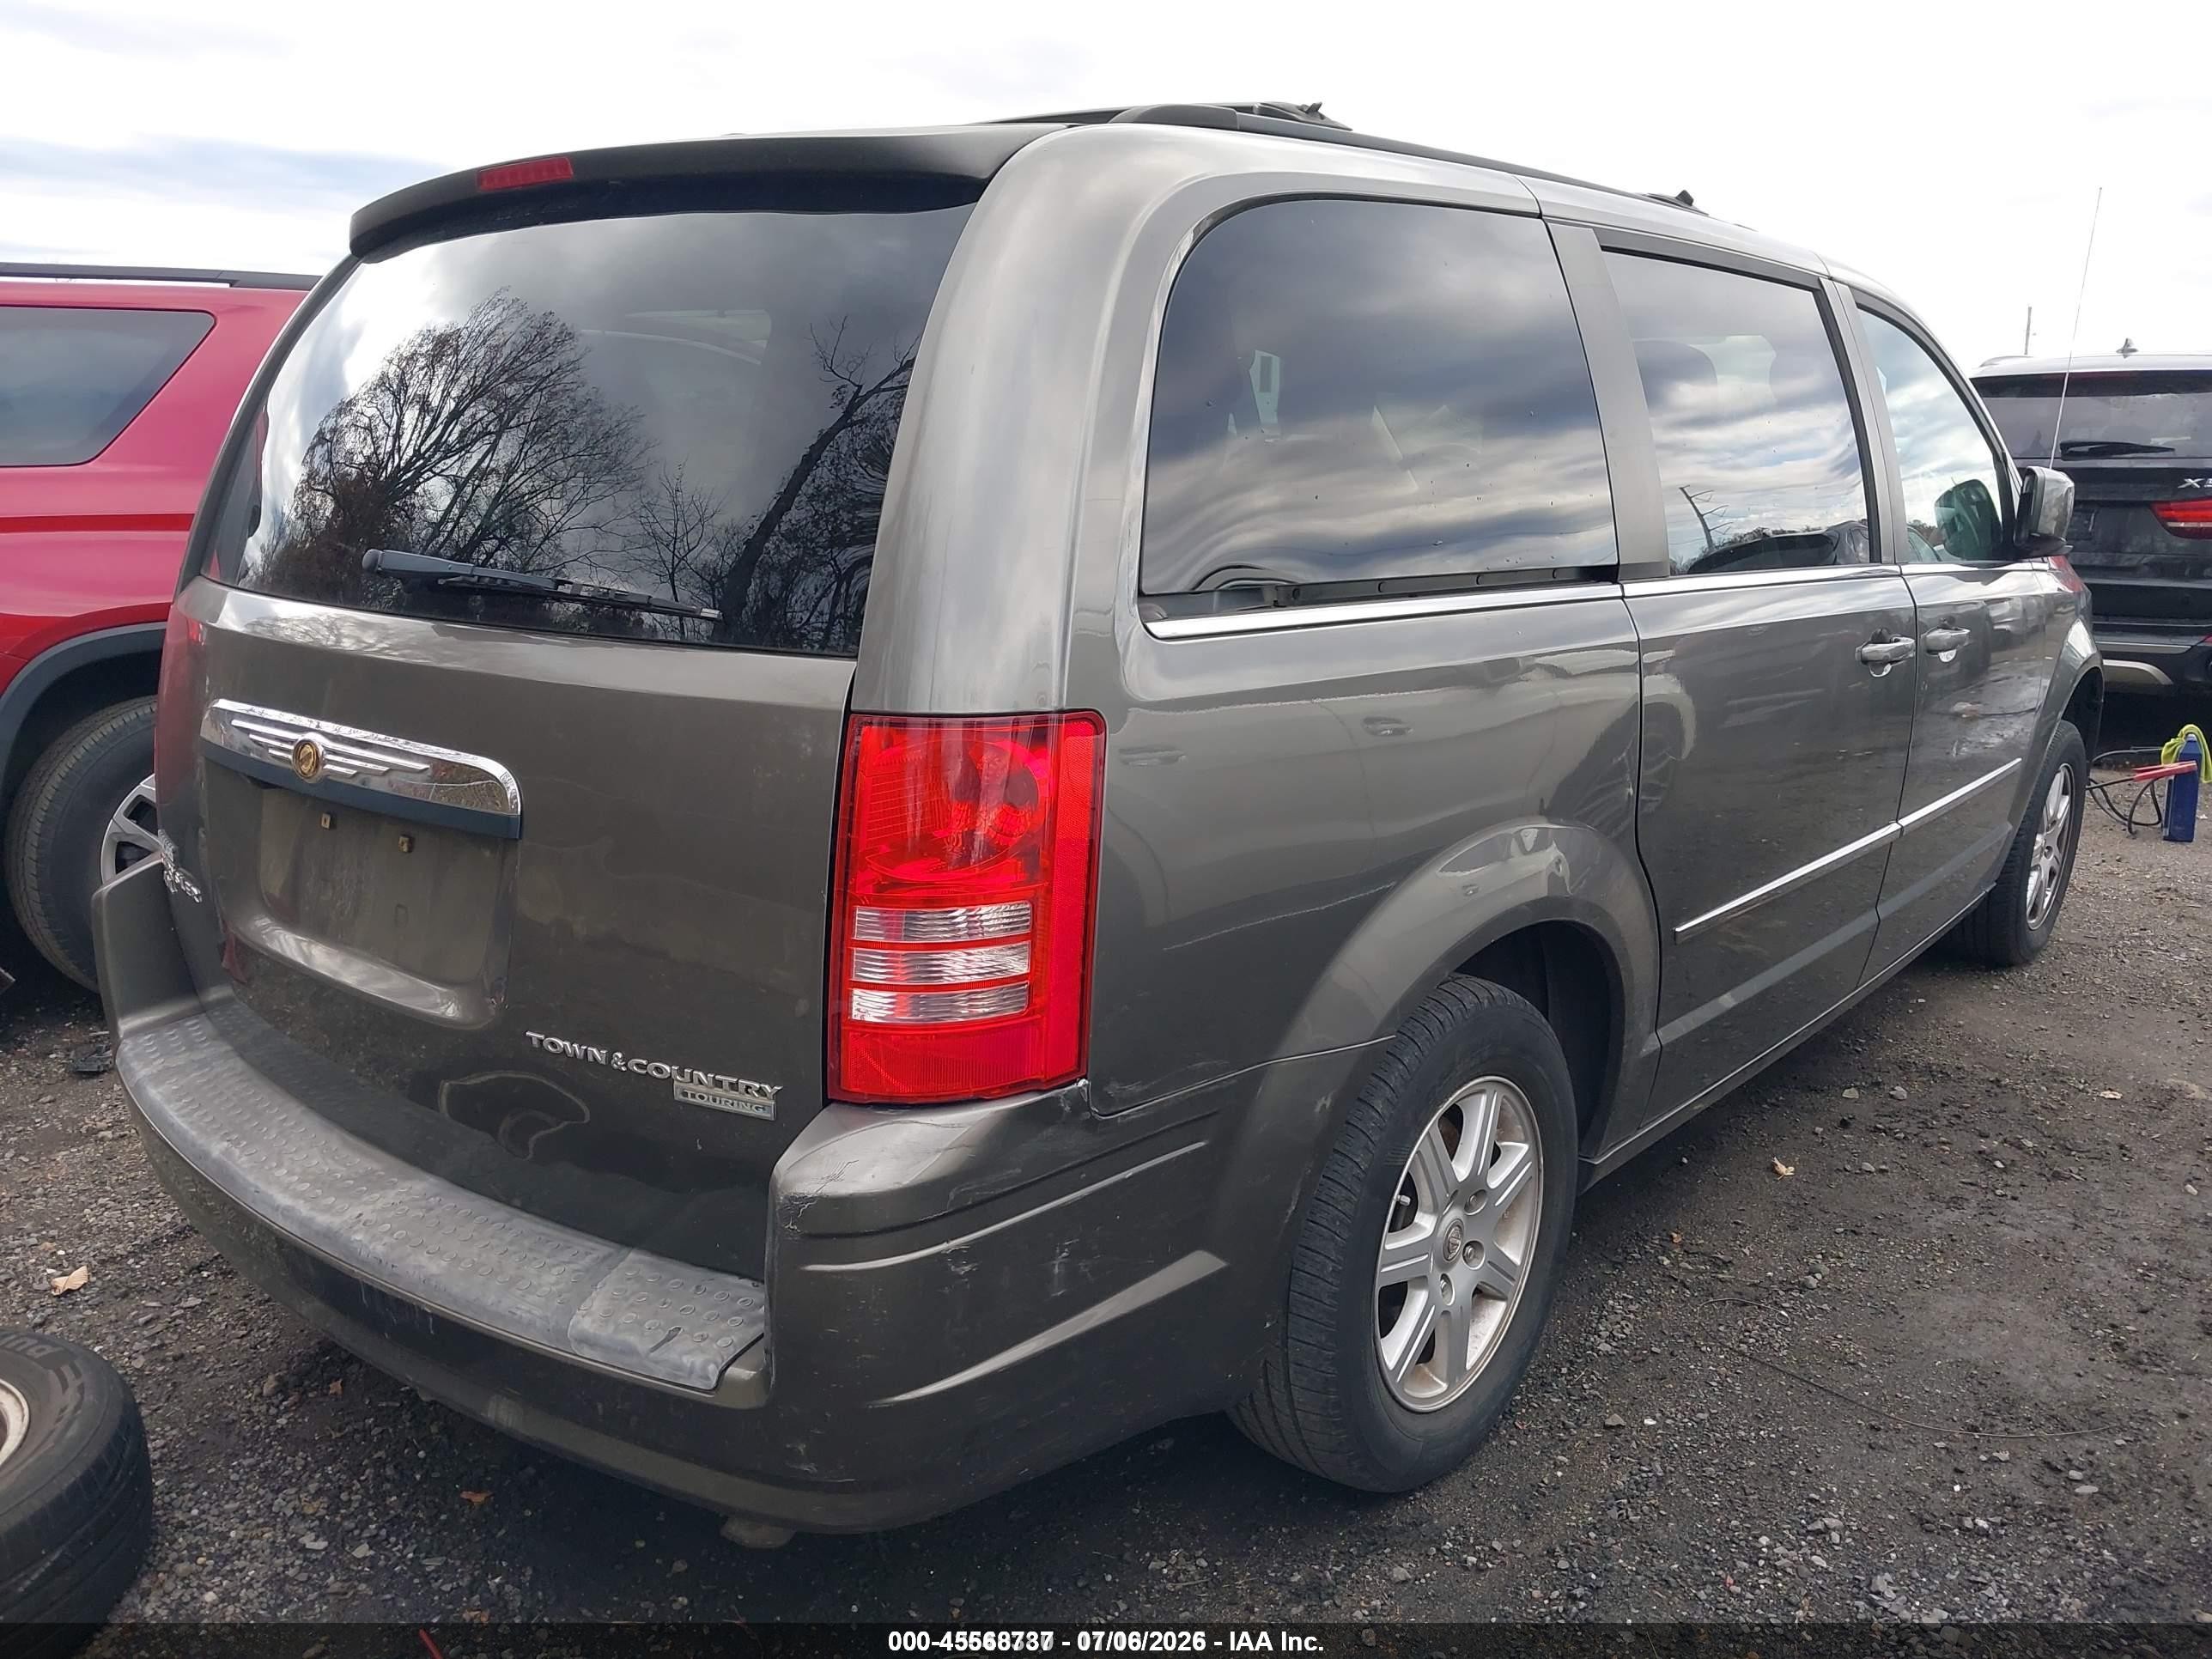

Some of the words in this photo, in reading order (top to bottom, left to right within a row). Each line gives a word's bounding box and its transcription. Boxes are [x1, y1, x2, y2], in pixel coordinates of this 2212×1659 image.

[525, 1030, 608, 1065] TOWN
[627, 1058, 783, 1100] COUNTRY
[683, 1089, 766, 1114] TOURING
